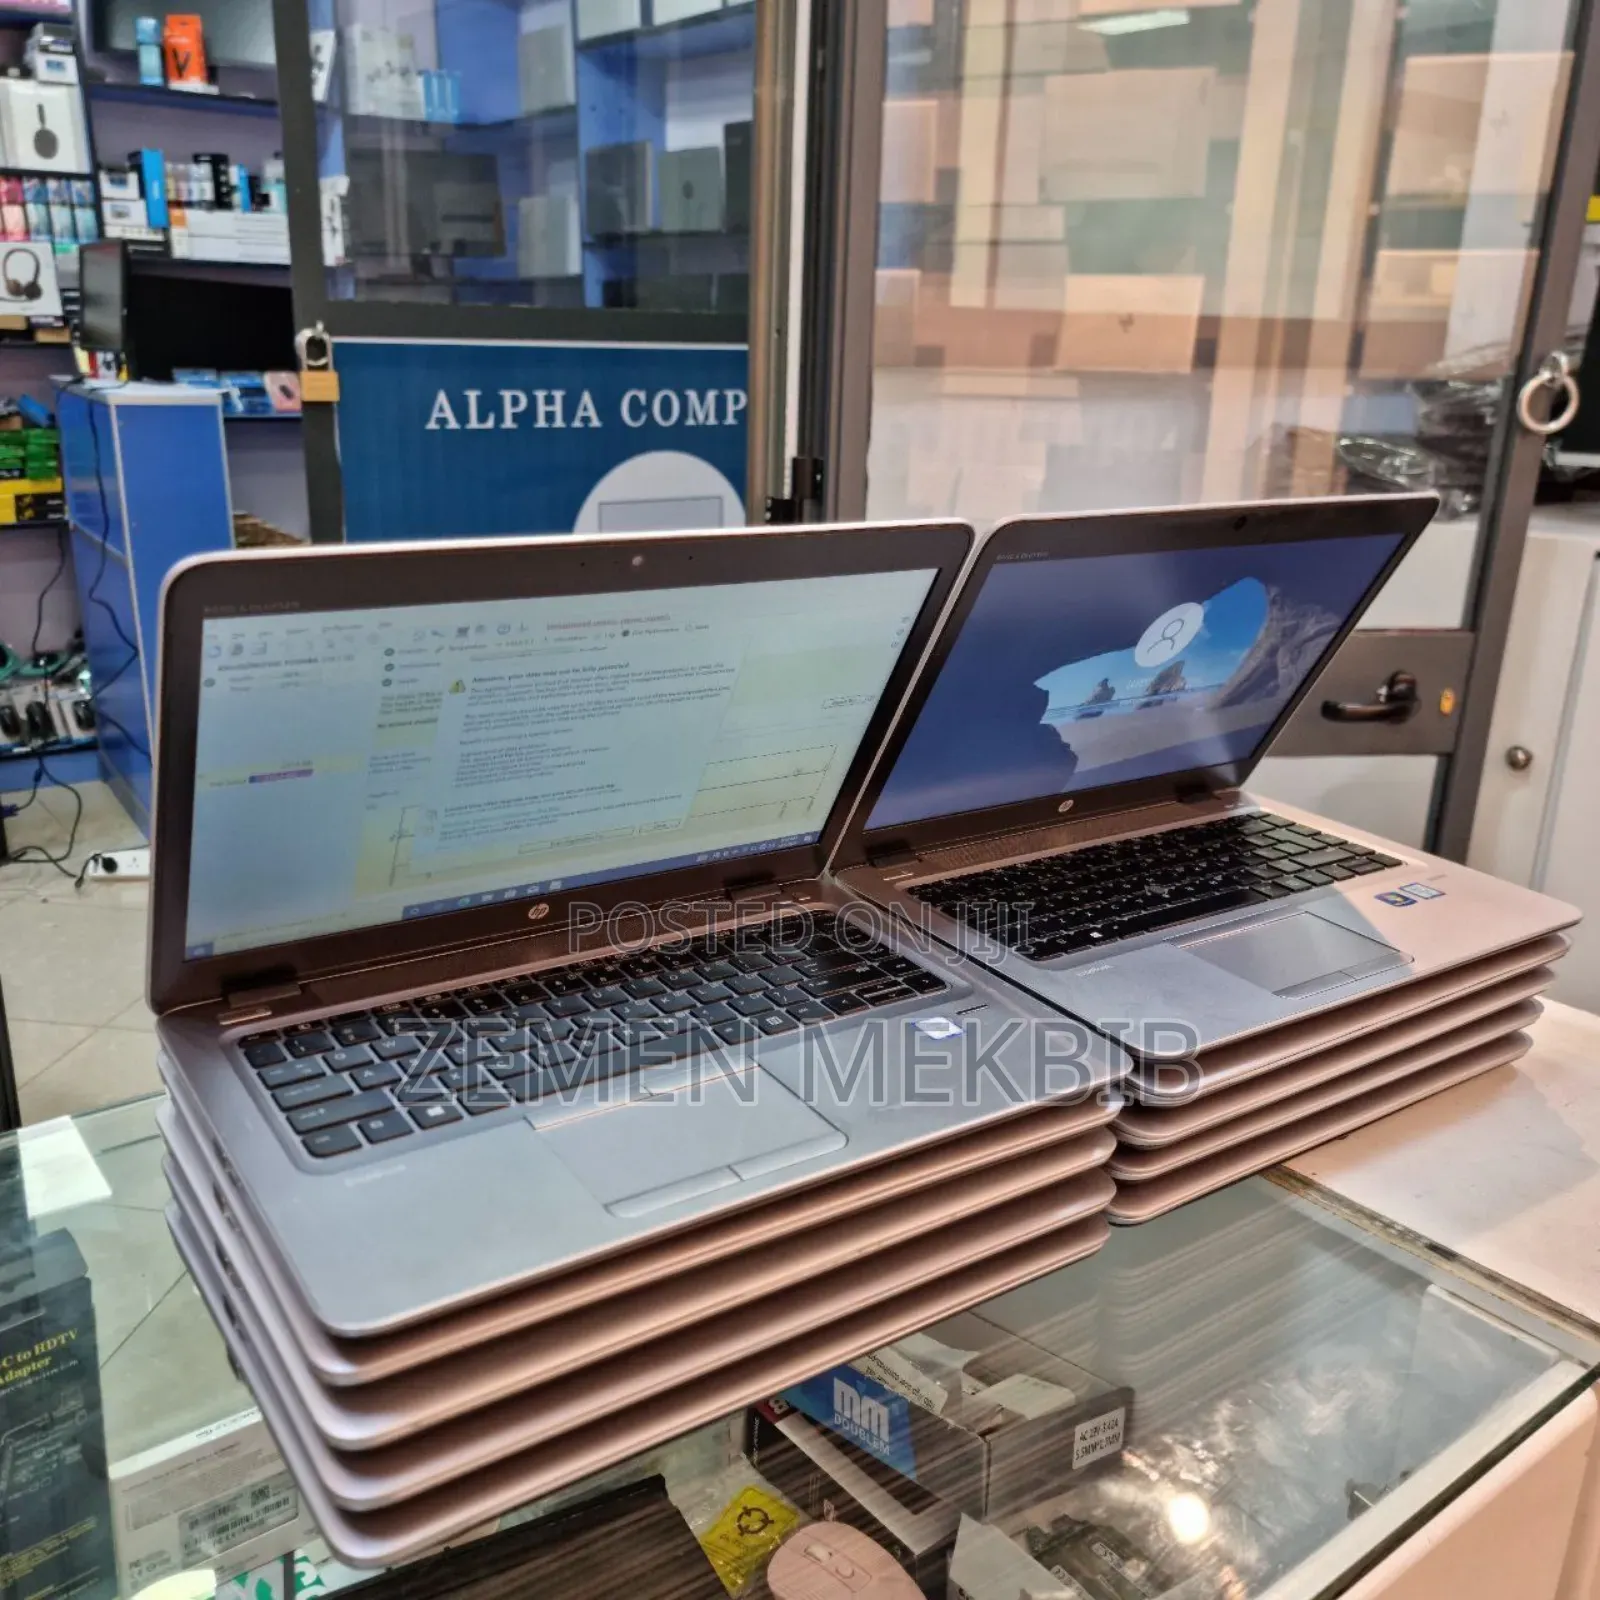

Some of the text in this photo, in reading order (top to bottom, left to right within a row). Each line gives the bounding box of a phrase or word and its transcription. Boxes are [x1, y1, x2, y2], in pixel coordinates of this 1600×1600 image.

[425, 388, 748, 430] ALPHA COMP
[528, 903, 550, 920] hp
[16, 1350, 32, 1363] to
[34, 1328, 79, 1356] HDTV
[834, 1411, 890, 1456] DOUBLEM
